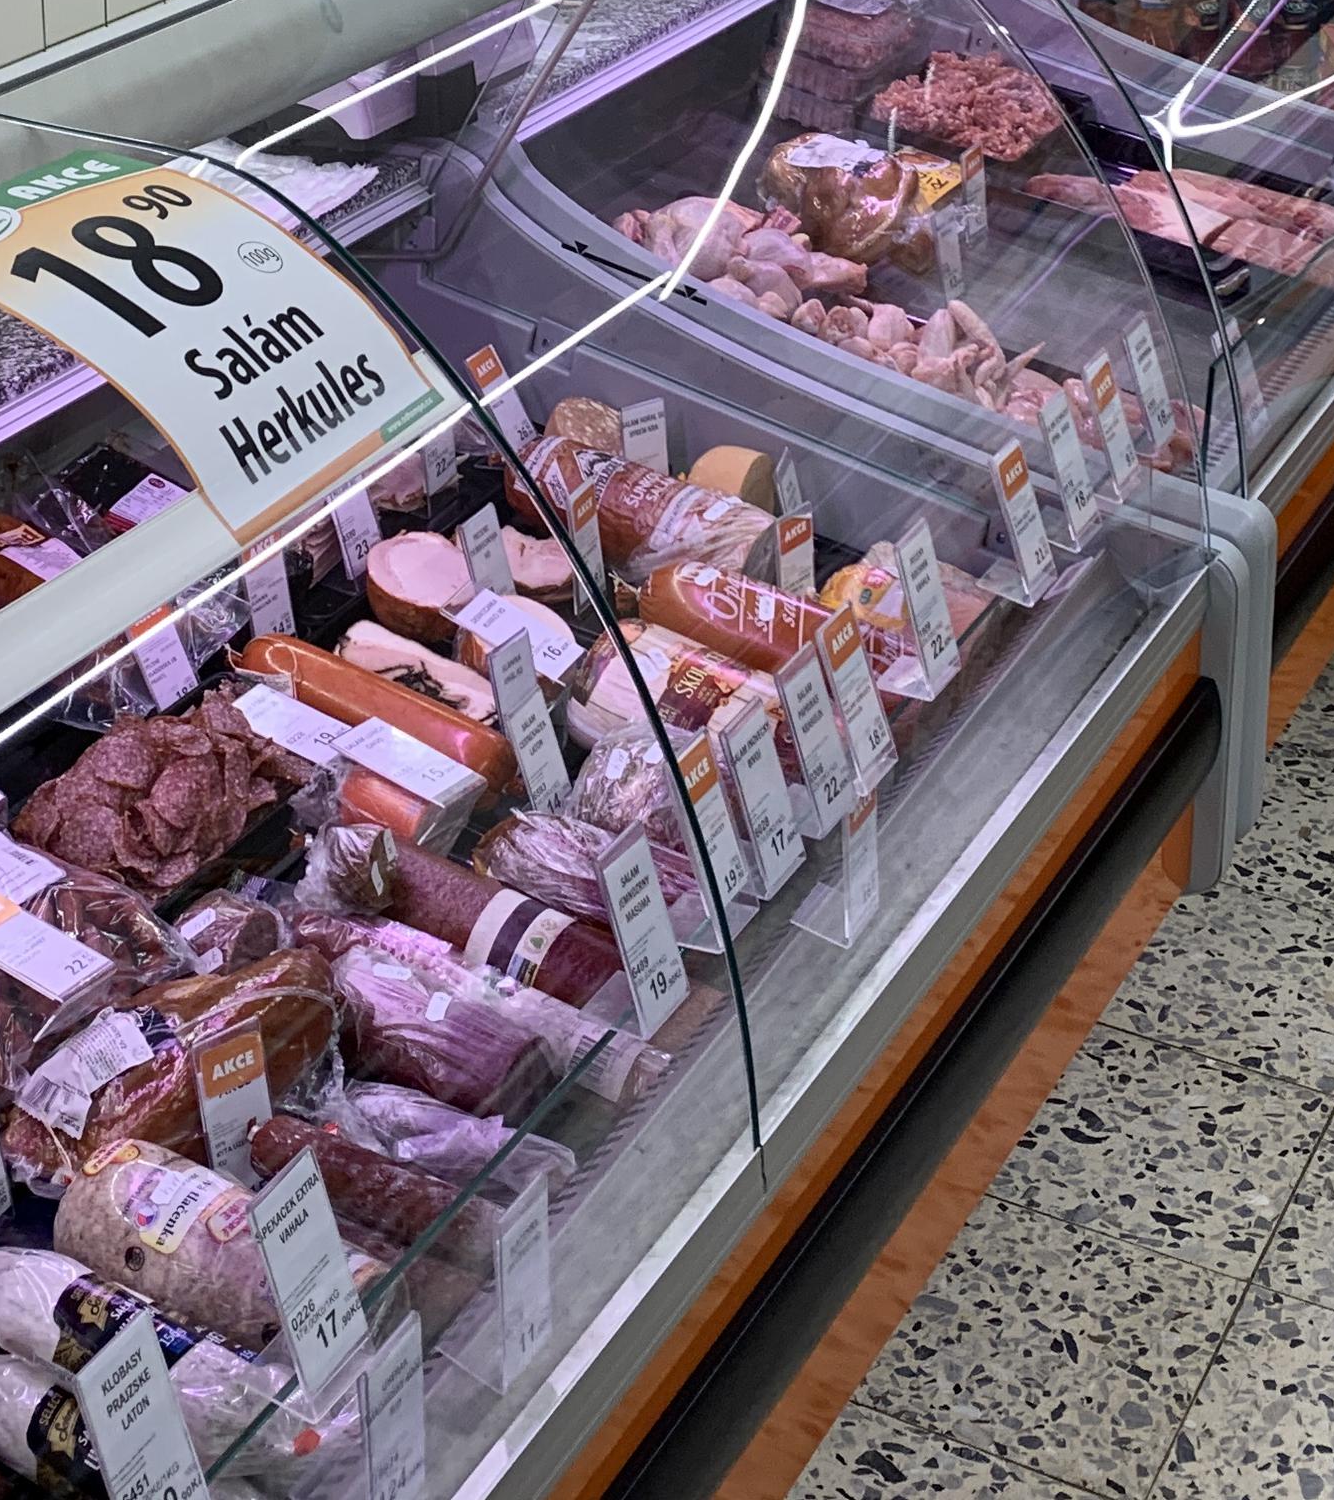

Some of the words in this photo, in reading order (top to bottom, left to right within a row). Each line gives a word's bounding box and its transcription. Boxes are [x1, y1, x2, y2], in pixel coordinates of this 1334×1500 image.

[7, 159, 120, 200] AKCE
[10, 215, 224, 339] 18
[122, 184, 193, 220] 90
[243, 247, 280, 267] 100g
[184, 304, 325, 402] Salám
[218, 352, 386, 487] Herkules
[355, 539, 369, 561] 23
[543, 645, 562, 661] 16
[831, 622, 855, 654] AKCE
[930, 634, 945, 660] 22
[421, 767, 445, 784] 15
[823, 777, 840, 805] 22
[770, 828, 785, 858] 17
[620, 864, 640, 888] SALAM
[724, 869, 738, 893] 19
[64, 959, 89, 977] 22
[649, 970, 667, 1000] 19
[212, 1049, 255, 1081] AKCE
[156, 1191, 200, 1247] tlačenka
[255, 1198, 297, 1245] SPEKACEK
[296, 1173, 320, 1204] EXTRA
[279, 1208, 309, 1245] VAHALA
[291, 1299, 316, 1332] 0226
[316, 1308, 337, 1348] 17
[101, 1347, 143, 1397] KLOBASY
[107, 1367, 152, 1418] PRAJZSKE
[121, 1396, 151, 1431] LATON
